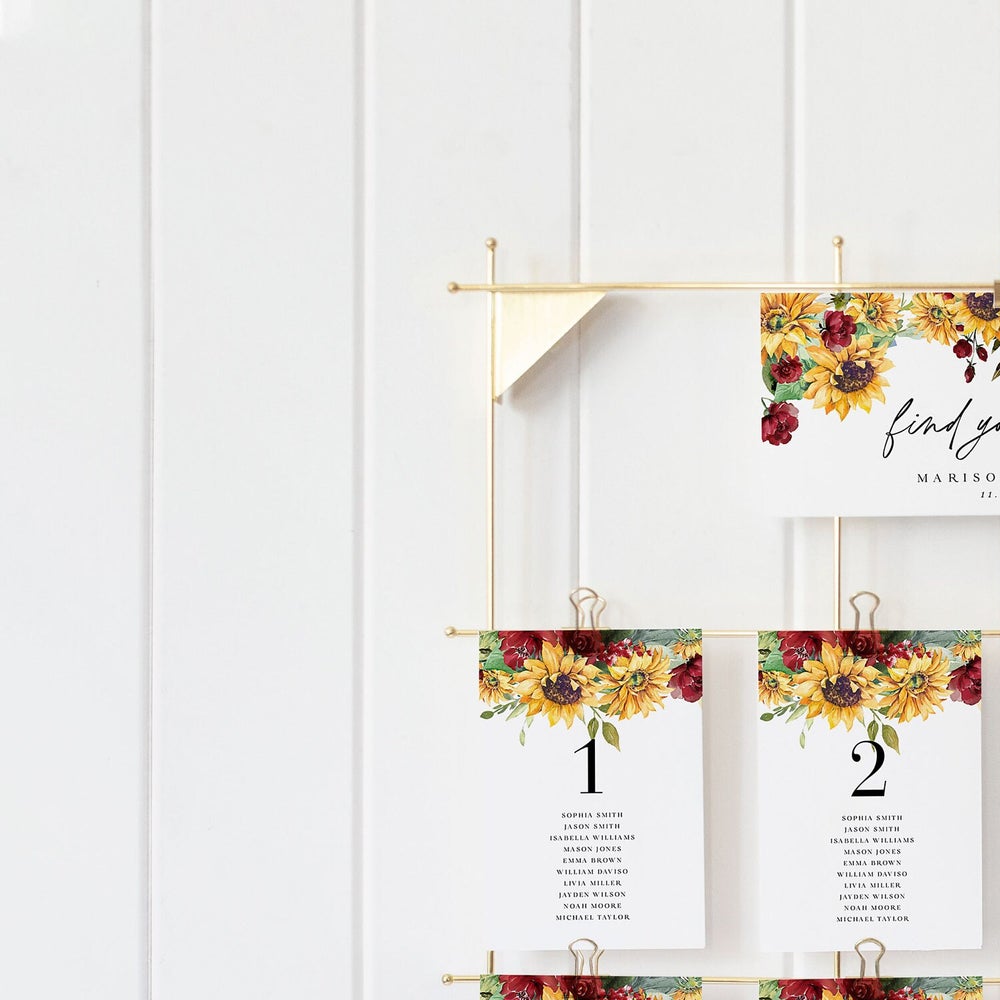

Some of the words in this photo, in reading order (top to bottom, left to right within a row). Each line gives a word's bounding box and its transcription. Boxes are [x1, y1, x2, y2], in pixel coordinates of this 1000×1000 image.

[882, 397, 973, 458] find
[574, 738, 603, 794] 1
[851, 740, 887, 797] 2
[561, 811, 593, 819] SOPHIA
[595, 811, 623, 819] SMITH
[844, 826, 870, 834] JASON
[872, 825, 900, 833] SMITH
[549, 834, 590, 842] ISABELLA
[843, 848, 873, 856] MASON
[875, 848, 902, 856] JONES
[590, 856, 622, 864] BROWN
[877, 870, 908, 878] DAVISO
[589, 879, 623, 887] MILLER
[839, 893, 870, 902] JAYDEN
[563, 902, 588, 910] NOAH
[590, 902, 622, 910] MOORE
[596, 913, 631, 921] TAYLOR
[836, 915, 875, 923] MICHAEL
[876, 915, 910, 923] TAYLOR
